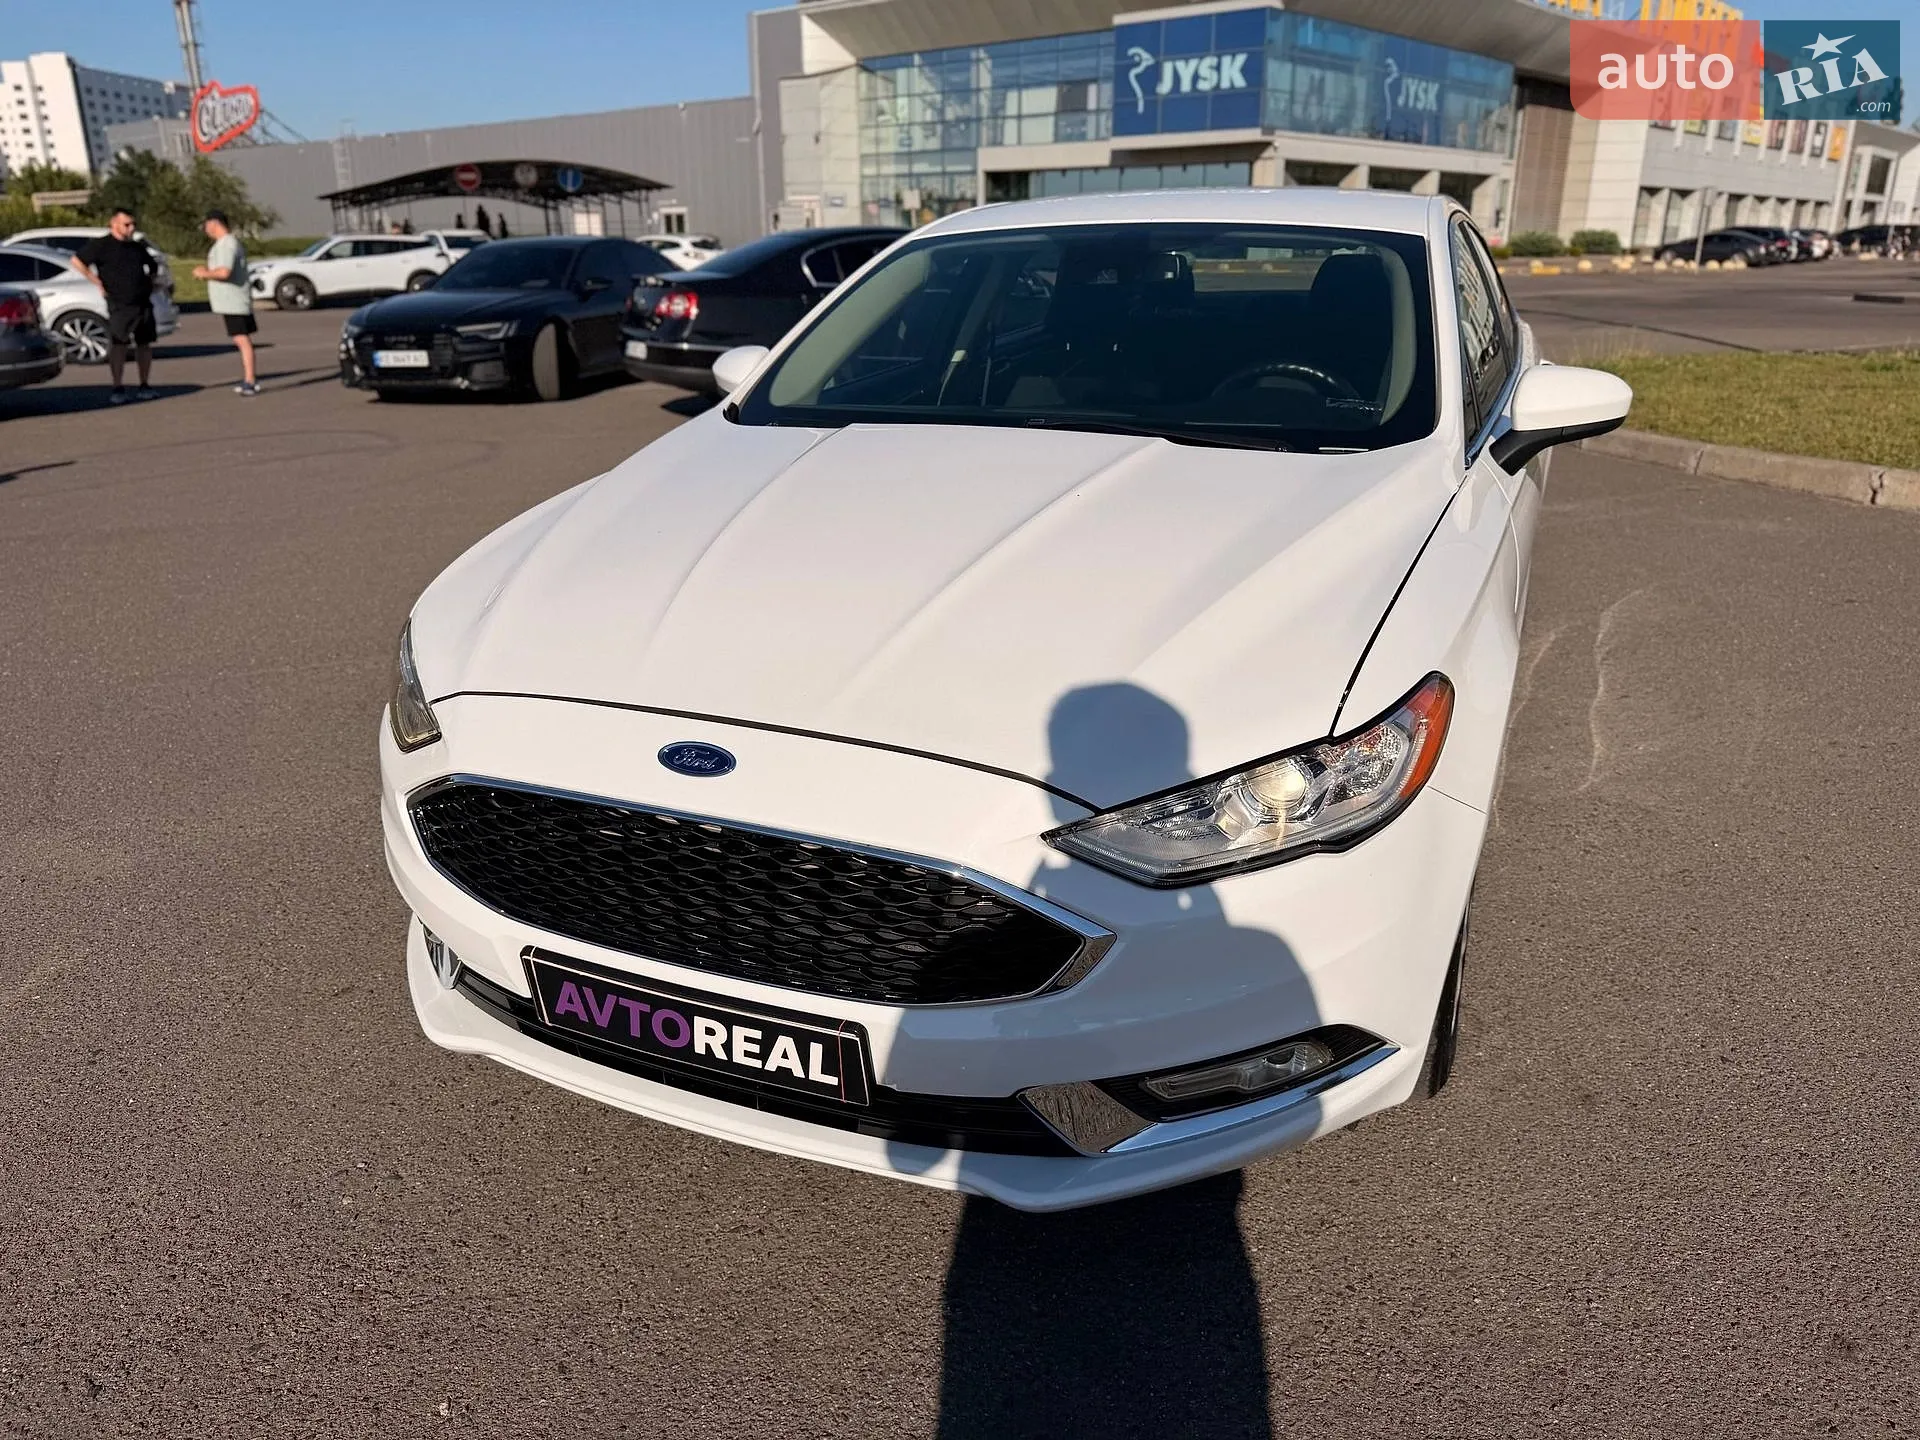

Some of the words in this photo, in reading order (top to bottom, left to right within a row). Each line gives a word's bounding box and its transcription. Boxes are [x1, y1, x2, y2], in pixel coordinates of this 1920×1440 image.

[1155, 53, 1249, 95] JYSK
[1397, 76, 1441, 112] JYSK
[672, 747, 719, 769] Ford
[554, 980, 839, 1086] AVTOREAL
